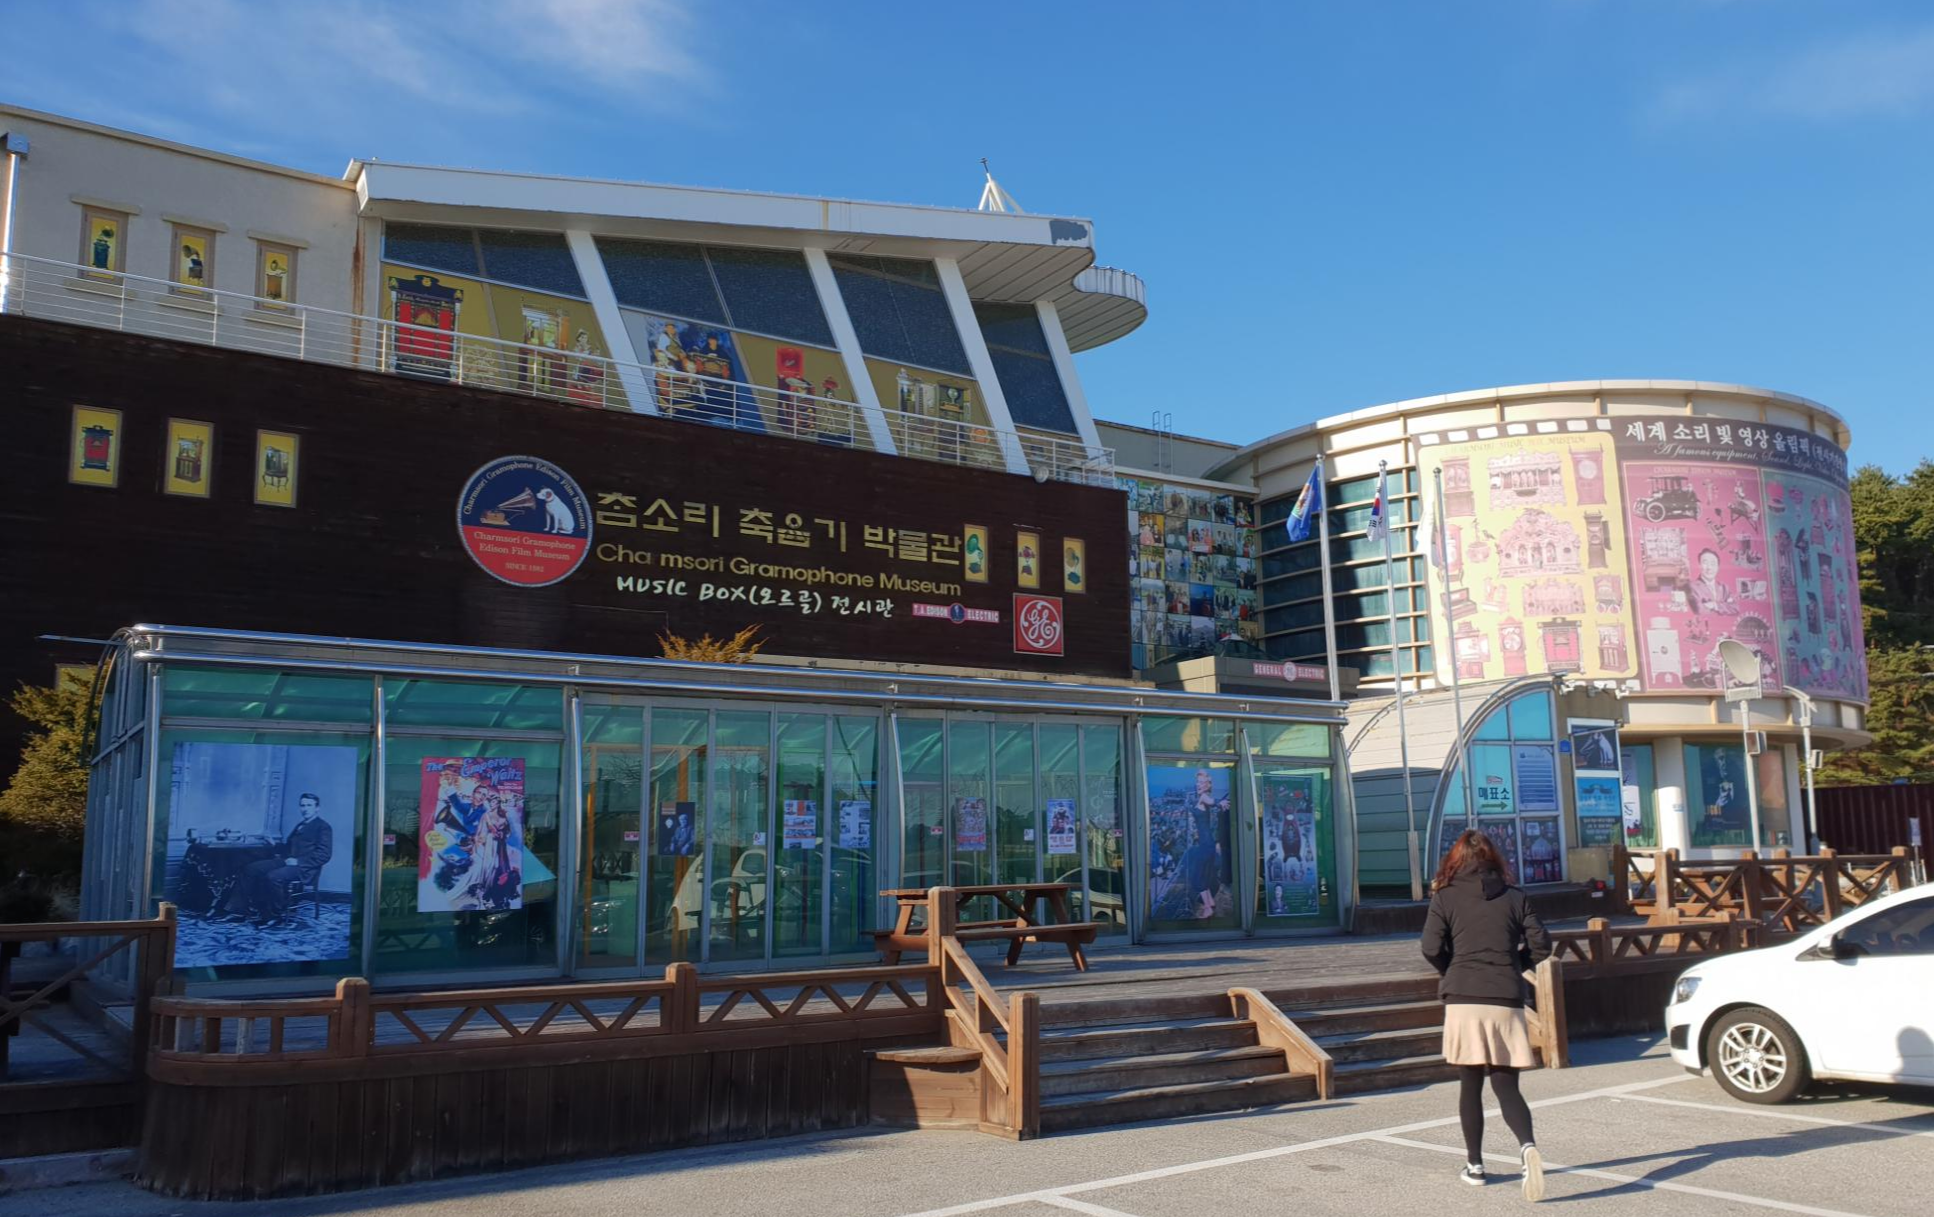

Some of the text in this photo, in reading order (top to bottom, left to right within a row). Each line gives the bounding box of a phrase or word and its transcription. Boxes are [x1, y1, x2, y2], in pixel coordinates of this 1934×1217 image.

[1625, 421, 1667, 442] 세계
[1673, 423, 1710, 443] 소리
[1716, 424, 1734, 445] 빛
[1738, 427, 1770, 449] 영상
[463, 461, 586, 530] Charmsori Gramophone Edison Film Museum
[473, 531, 576, 551] Charmsori Gramophone
[739, 508, 847, 552] 축음기
[863, 524, 962, 566] 박물관
[479, 543, 570, 561] Edison Film Museum
[729, 557, 875, 588] Gramophone
[880, 572, 961, 596] Museum
[616, 576, 688, 597] MUSIC
[831, 595, 895, 618] 전시관
[967, 609, 999, 623] ELECTRIC
[1254, 663, 1282, 676] GENERAL
[1298, 668, 1325, 680] ELECTRIC
[426, 758, 512, 777] The Emperor
[1478, 786, 1511, 801] 매표소
